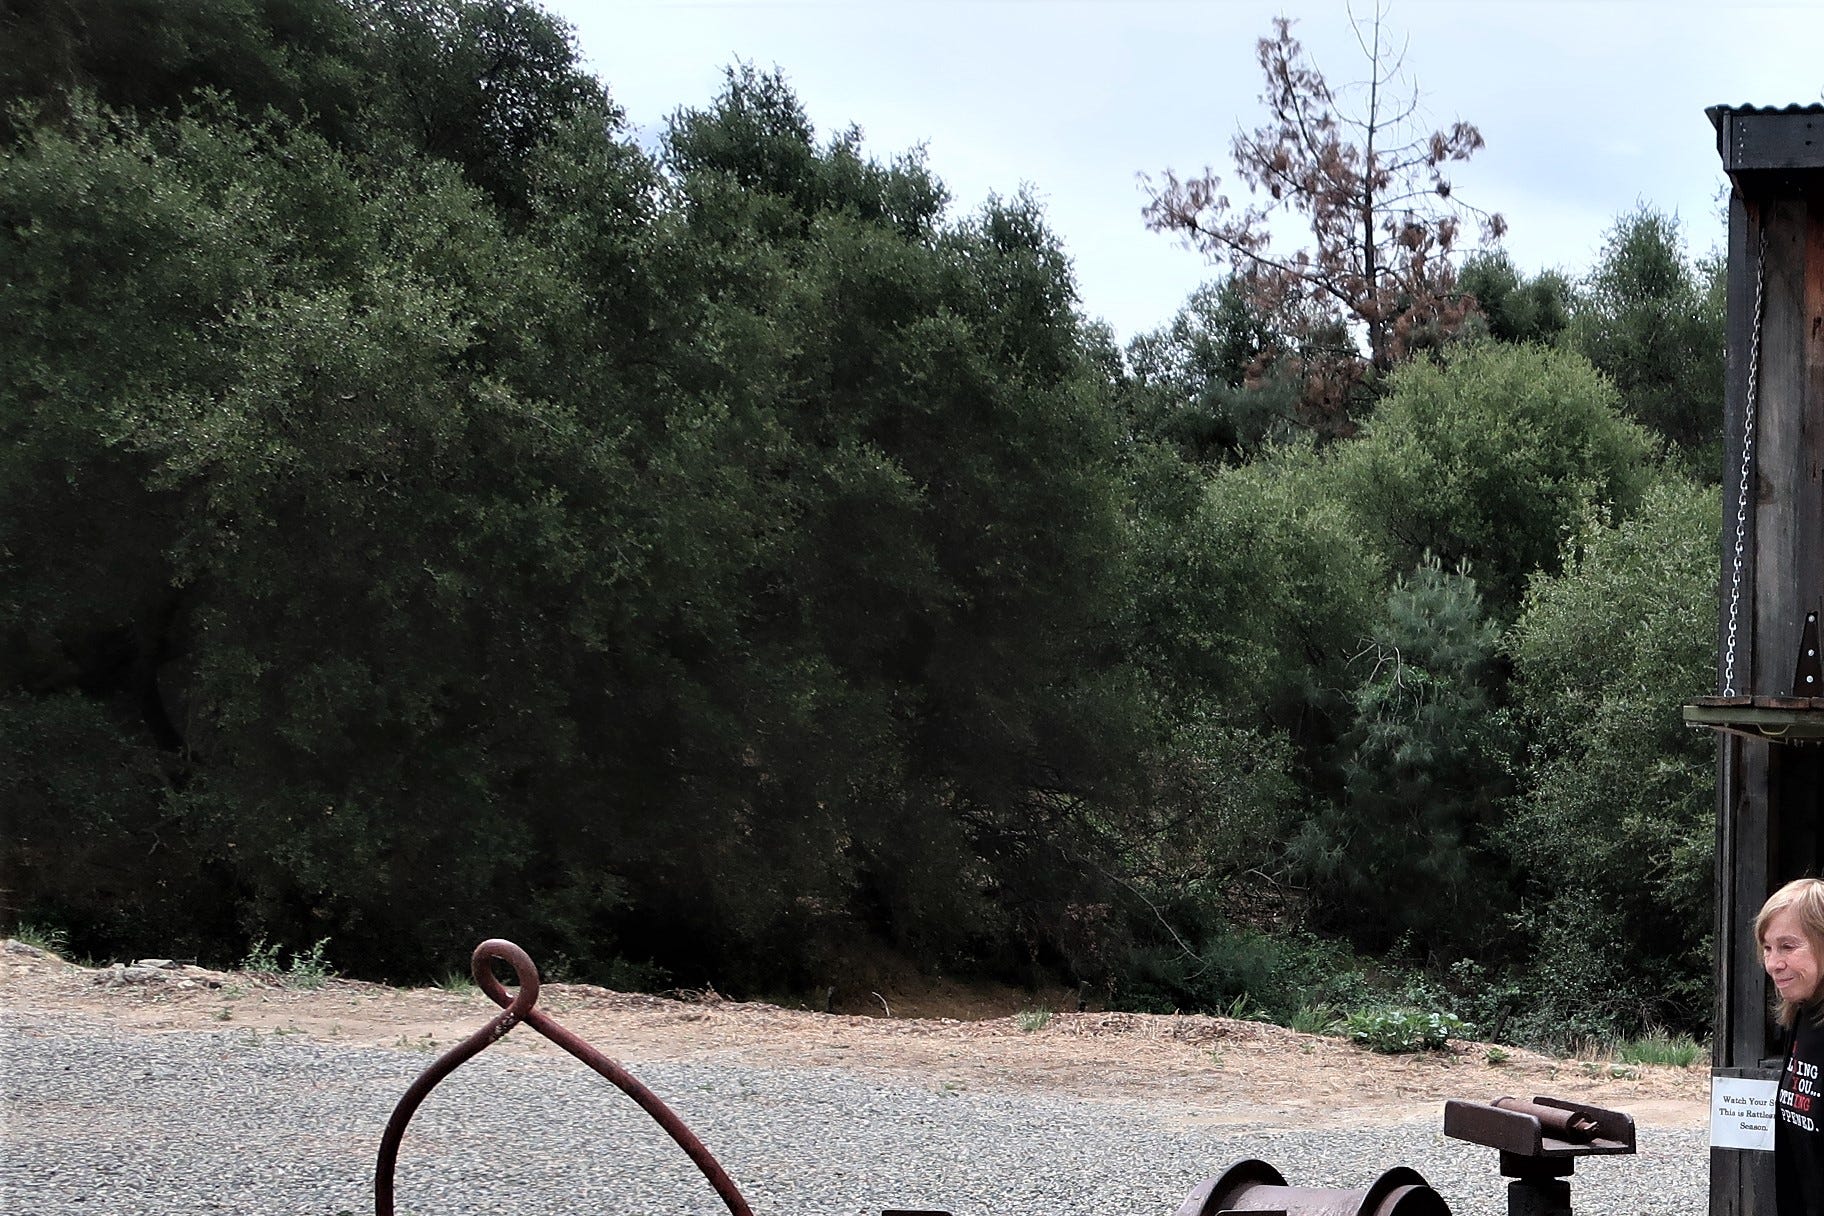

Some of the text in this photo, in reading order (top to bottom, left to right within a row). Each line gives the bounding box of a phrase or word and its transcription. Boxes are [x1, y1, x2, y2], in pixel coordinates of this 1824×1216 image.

[1723, 1095, 1747, 1105] Watch
[1749, 1097, 1768, 1106] Your
[1779, 1089, 1811, 1111] OTHING
[1719, 1107, 1736, 1116] This
[1746, 1109, 1776, 1119] Rattles
[1739, 1121, 1769, 1131] Season.
[1780, 1108, 1821, 1133] PPENED.
